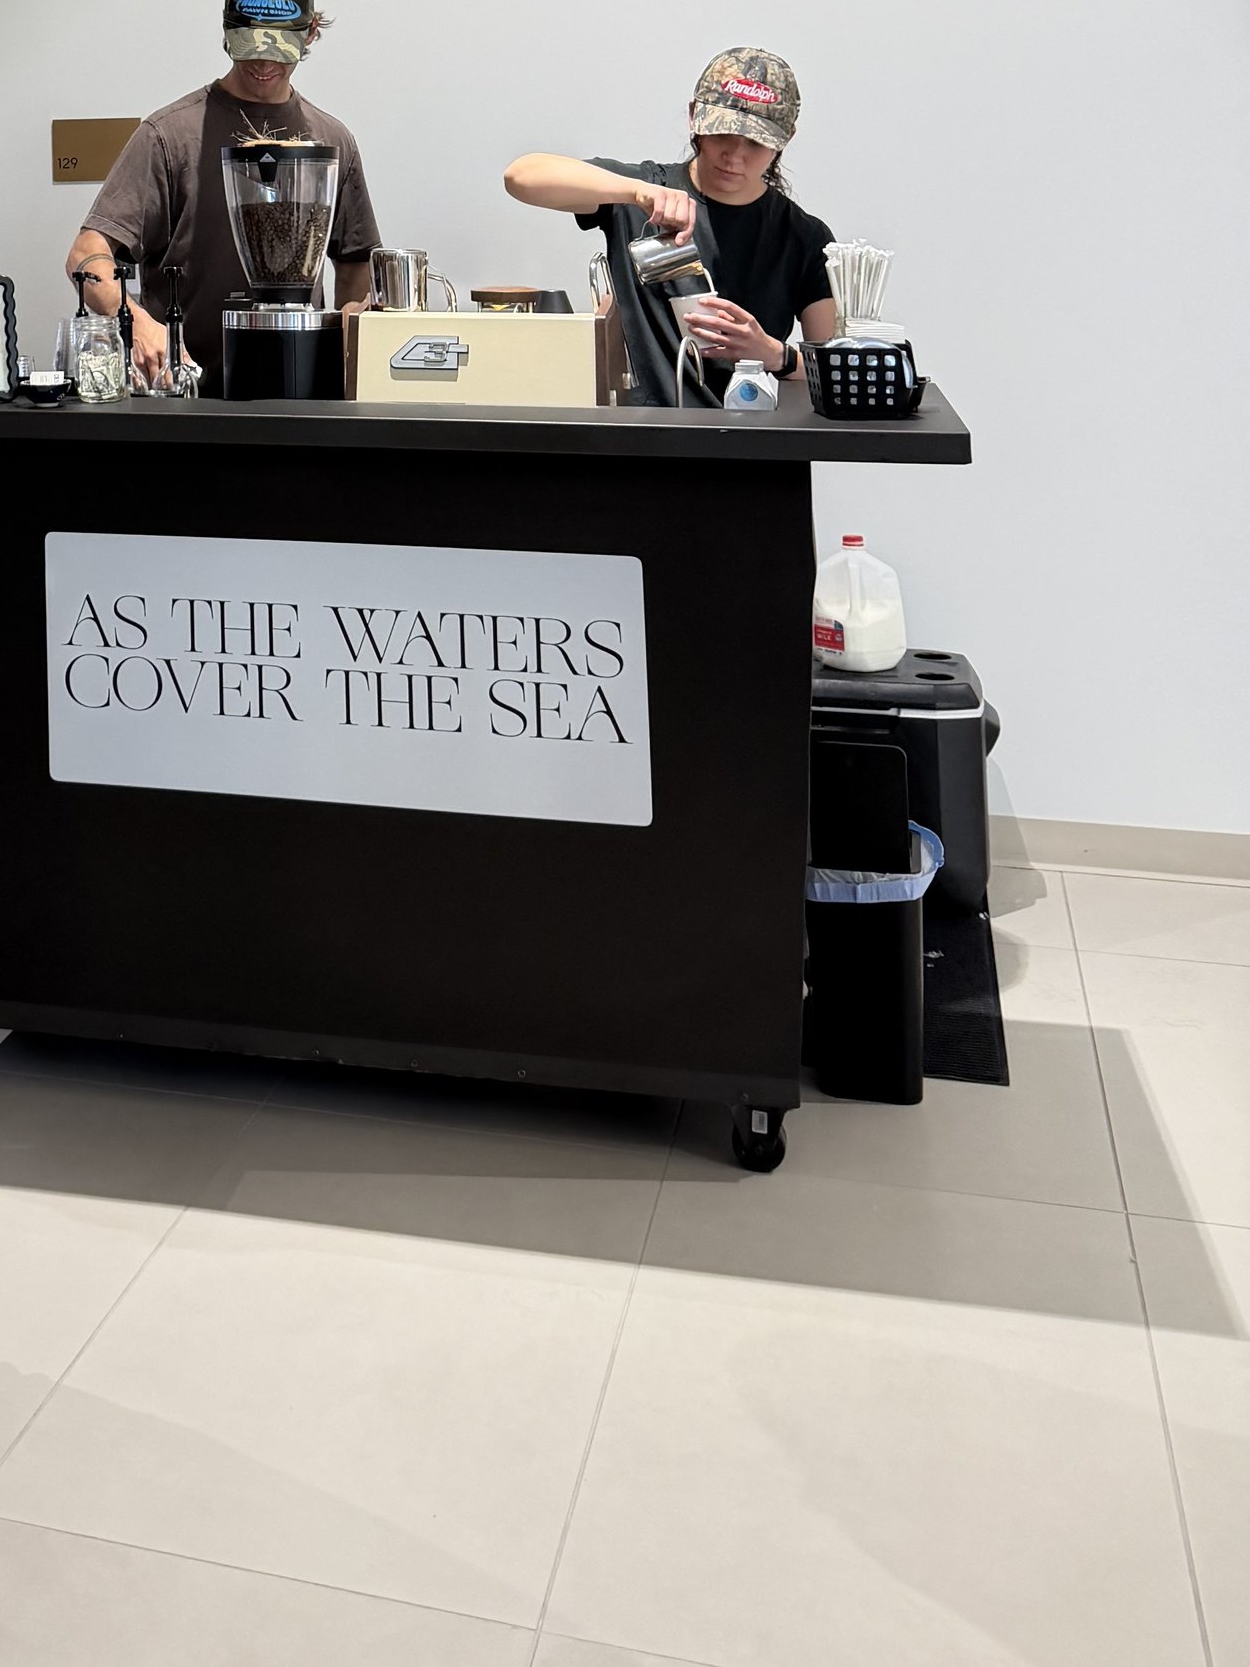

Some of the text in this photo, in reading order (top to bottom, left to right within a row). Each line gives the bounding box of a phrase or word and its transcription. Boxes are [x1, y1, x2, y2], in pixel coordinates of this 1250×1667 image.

[724, 79, 776, 103] Randolph
[57, 157, 79, 170] 129
[61, 593, 626, 679] AS THE WATERS
[64, 653, 634, 745] COVER THE SEA
